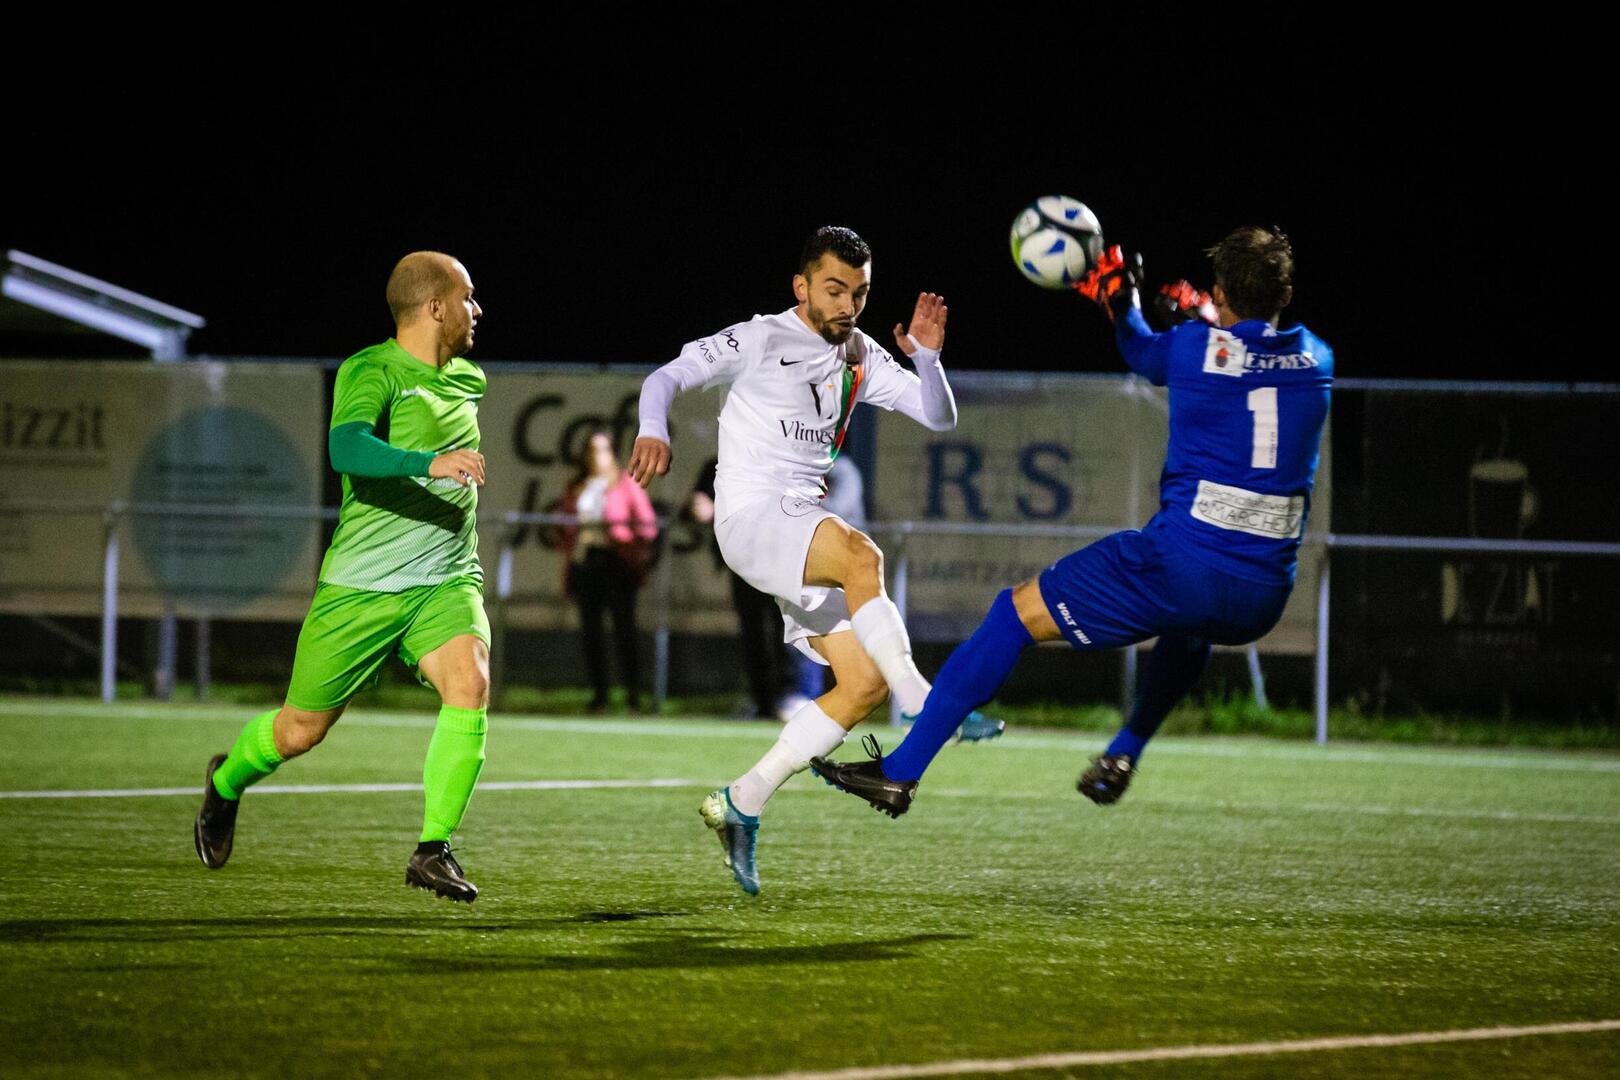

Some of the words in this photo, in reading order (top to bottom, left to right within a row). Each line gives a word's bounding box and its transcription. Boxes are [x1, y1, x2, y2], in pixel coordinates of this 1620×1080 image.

[512, 392, 674, 467] Caf
[1247, 386, 1279, 469] 1
[1057, 602, 1077, 626] VOLT
